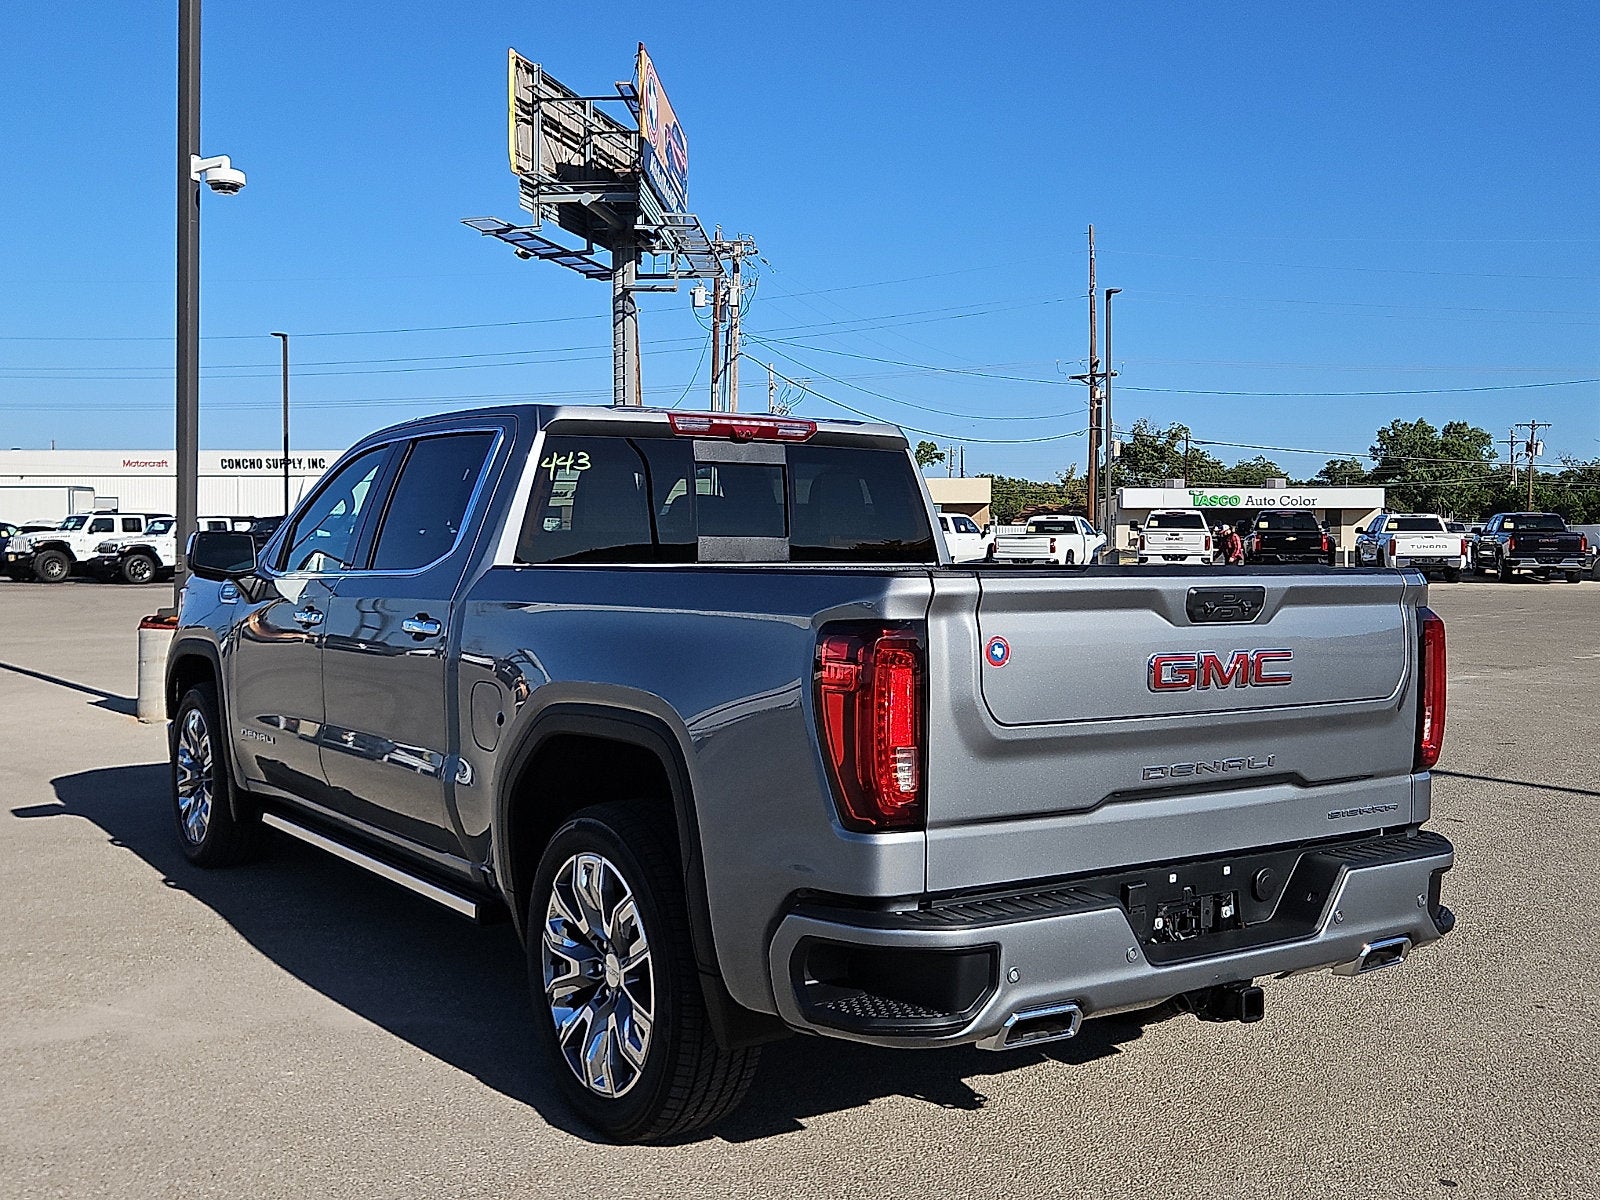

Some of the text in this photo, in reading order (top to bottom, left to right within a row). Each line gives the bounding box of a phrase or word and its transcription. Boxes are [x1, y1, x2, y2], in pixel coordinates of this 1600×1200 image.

[122, 459, 168, 468] Motorcraft
[220, 458, 328, 471] CONCHO SUPPLY, INC.
[541, 451, 591, 481] 443
[1189, 490, 1317, 506] TASCO Auto Color
[1147, 648, 1293, 693] GMC
[240, 729, 276, 745] DENALI
[1142, 754, 1276, 780] DENALI
[1327, 803, 1399, 820] SIERRA
